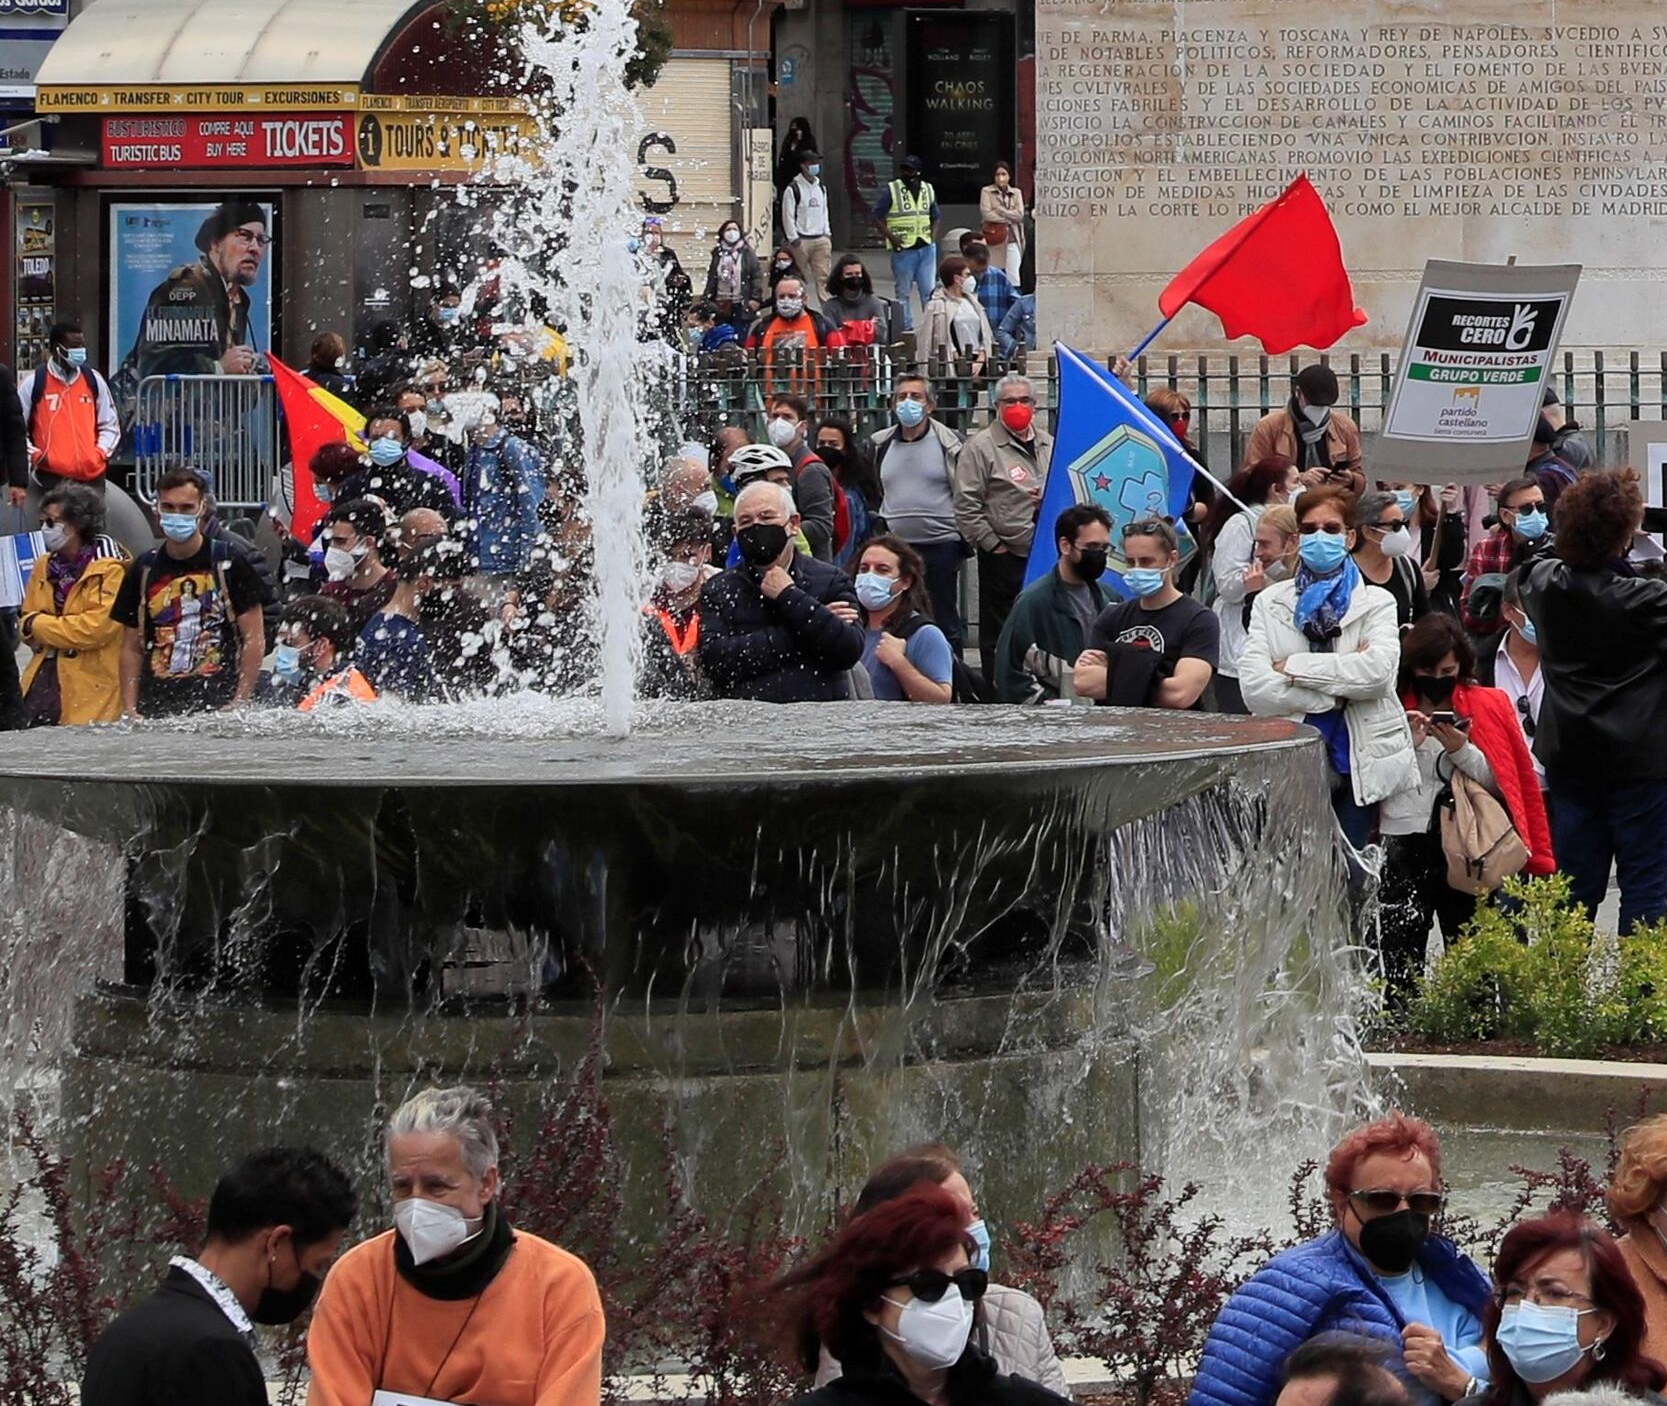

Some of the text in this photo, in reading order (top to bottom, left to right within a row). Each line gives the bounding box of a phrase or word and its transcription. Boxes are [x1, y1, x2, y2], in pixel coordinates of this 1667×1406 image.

[1061, 31, 1083, 44] DE
[1160, 30, 1249, 44] PIACENZA
[1279, 29, 1350, 42] TOSCANA
[1379, 28, 1409, 42] REY
[1080, 47, 1165, 60] NOTABLES
[1442, 44, 1560, 59] PENSADORES
[934, 80, 986, 94] CHAOS
[39, 91, 340, 106] FLAMENCO TRANSFER CITY TOUR EXCURSIONES
[925, 97, 994, 111] WALKING
[199, 121, 232, 136] COMPRE
[261, 119, 345, 158] TICKETS
[385, 124, 434, 158] TOURS
[1154, 132, 1297, 146] ESTABLECIENDO
[109, 144, 182, 162] TURISTIC BUS
[206, 142, 247, 157] BUY HERE
[1118, 203, 1138, 216] LA
[1149, 202, 1200, 216] CORTE
[1345, 202, 1396, 215] COMO
[1403, 202, 1421, 215] EL
[1429, 201, 1482, 216] MEJOR
[1489, 201, 1564, 215] ALCALDE
[23, 257, 51, 276] TOLEDO
[168, 291, 197, 302] DEPP
[1451, 314, 1511, 328] RECORTES
[146, 318, 219, 343] MINAMATA
[1460, 327, 1507, 345] CERO
[1422, 350, 1538, 365] MUNICIPALISTAS
[1429, 368, 1526, 383] GRUPO VERDE
[45, 393, 59, 412] 7
[1440, 407, 1477, 418] partido
[1438, 417, 1488, 428] castellano
